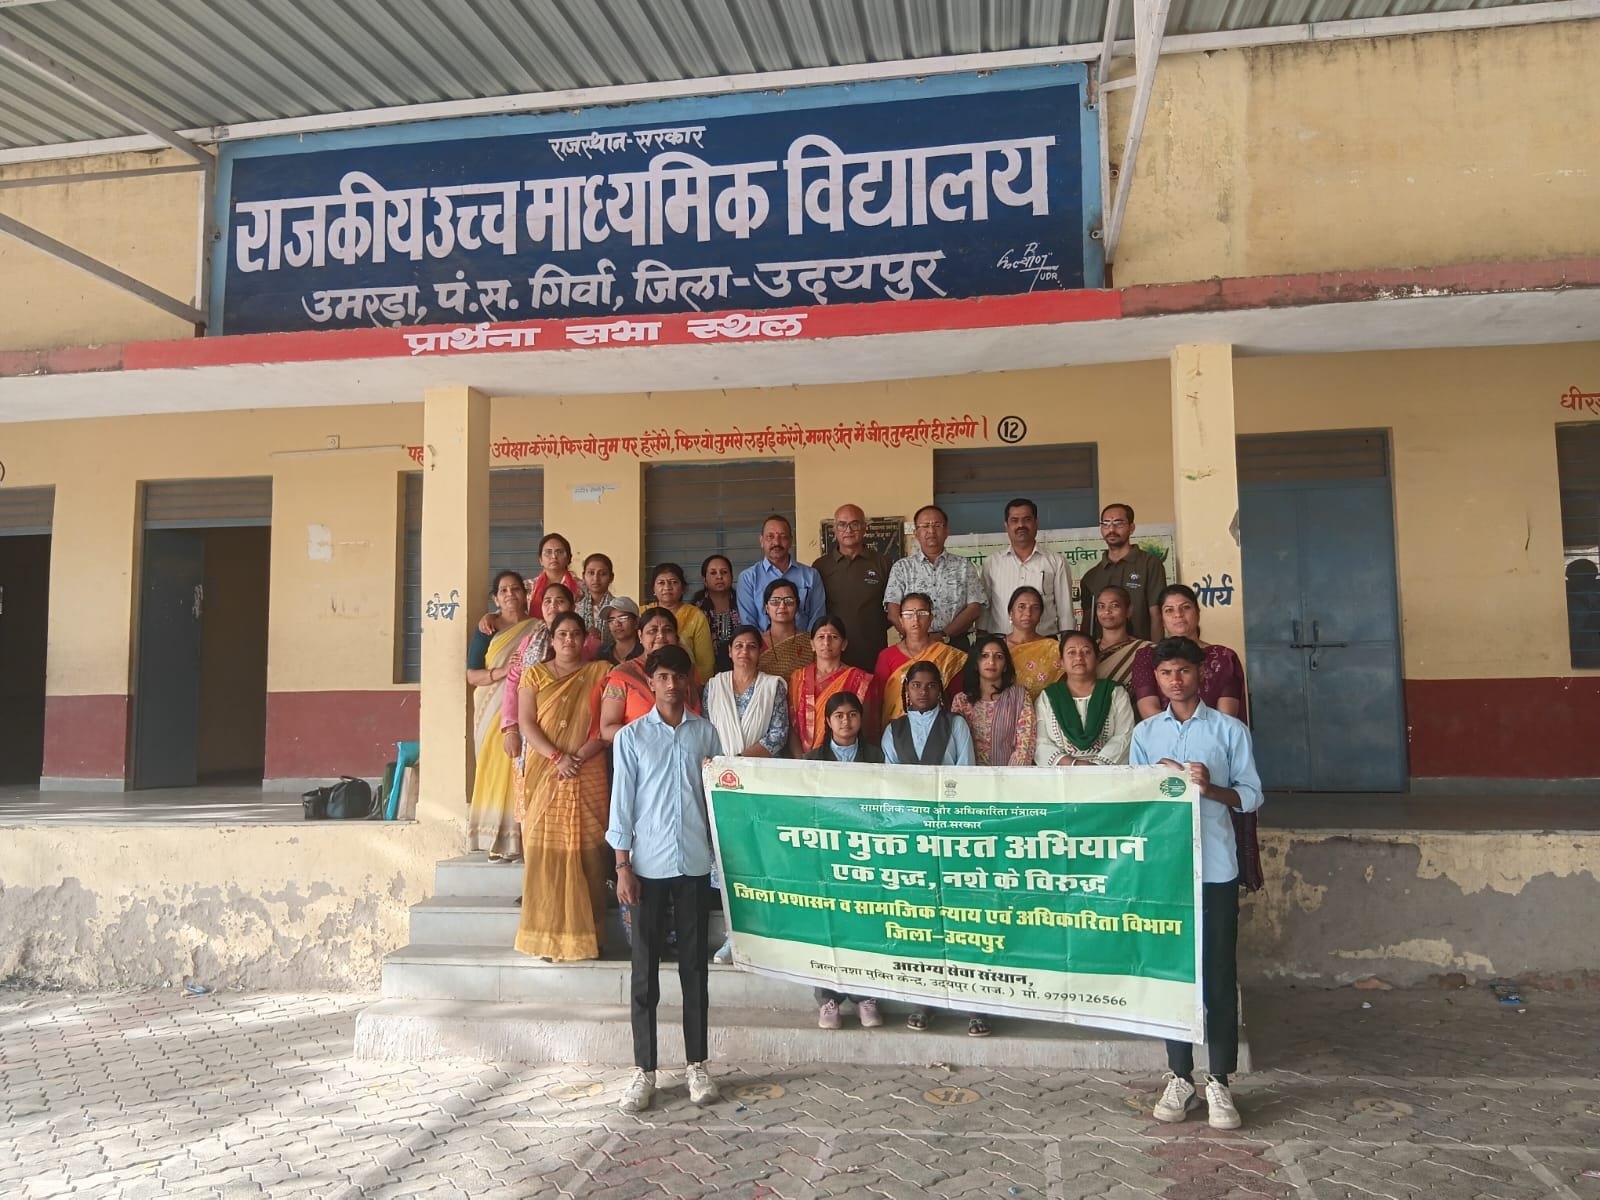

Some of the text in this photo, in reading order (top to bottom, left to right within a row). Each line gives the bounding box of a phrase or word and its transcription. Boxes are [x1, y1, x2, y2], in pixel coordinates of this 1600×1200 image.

[235, 134, 1056, 273] राजकीय उच्च माध्यमिक विद्यालय
[403, 313, 808, 355] प्रार्थना सभा स्थल
[492, 437, 529, 461] उपेक्षा
[598, 437, 620, 461] तुम
[621, 437, 639, 457] पर
[674, 429, 701, 453] फिर
[701, 428, 714, 451] वो
[744, 426, 776, 453] लड़ाई
[805, 429, 835, 451] मगर
[833, 422, 852, 450] अंत
[854, 421, 865, 442] में
[866, 420, 890, 448] जीत
[890, 418, 931, 448] तुम्हारी
[931, 418, 945, 444] ही
[945, 414, 979, 444] होगी
[859, 802, 1048, 816] सामाजिक न्याय और अधिकारिता मंत्रालय
[923, 820, 982, 829] भारत सरकार
[776, 826, 1148, 861] नशा मुक्त भारत अभियान
[831, 863, 875, 882] एक
[942, 867, 989, 888] नशे
[993, 868, 1020, 889] के
[1024, 868, 1108, 894] विरुद्ध
[732, 882, 1182, 936] जिला प्रशासन व सामाजिक न्याय एवं अधिकारिता विभाग
[810, 959, 837, 974] जिला
[840, 965, 862, 976] नशा
[864, 968, 894, 980] मुक्ति
[929, 978, 970, 992] उदयपुर
[1044, 991, 1127, 1006] 9799126566
[892, 961, 945, 976] आरोग्य
[947, 964, 975, 978] सेवा
